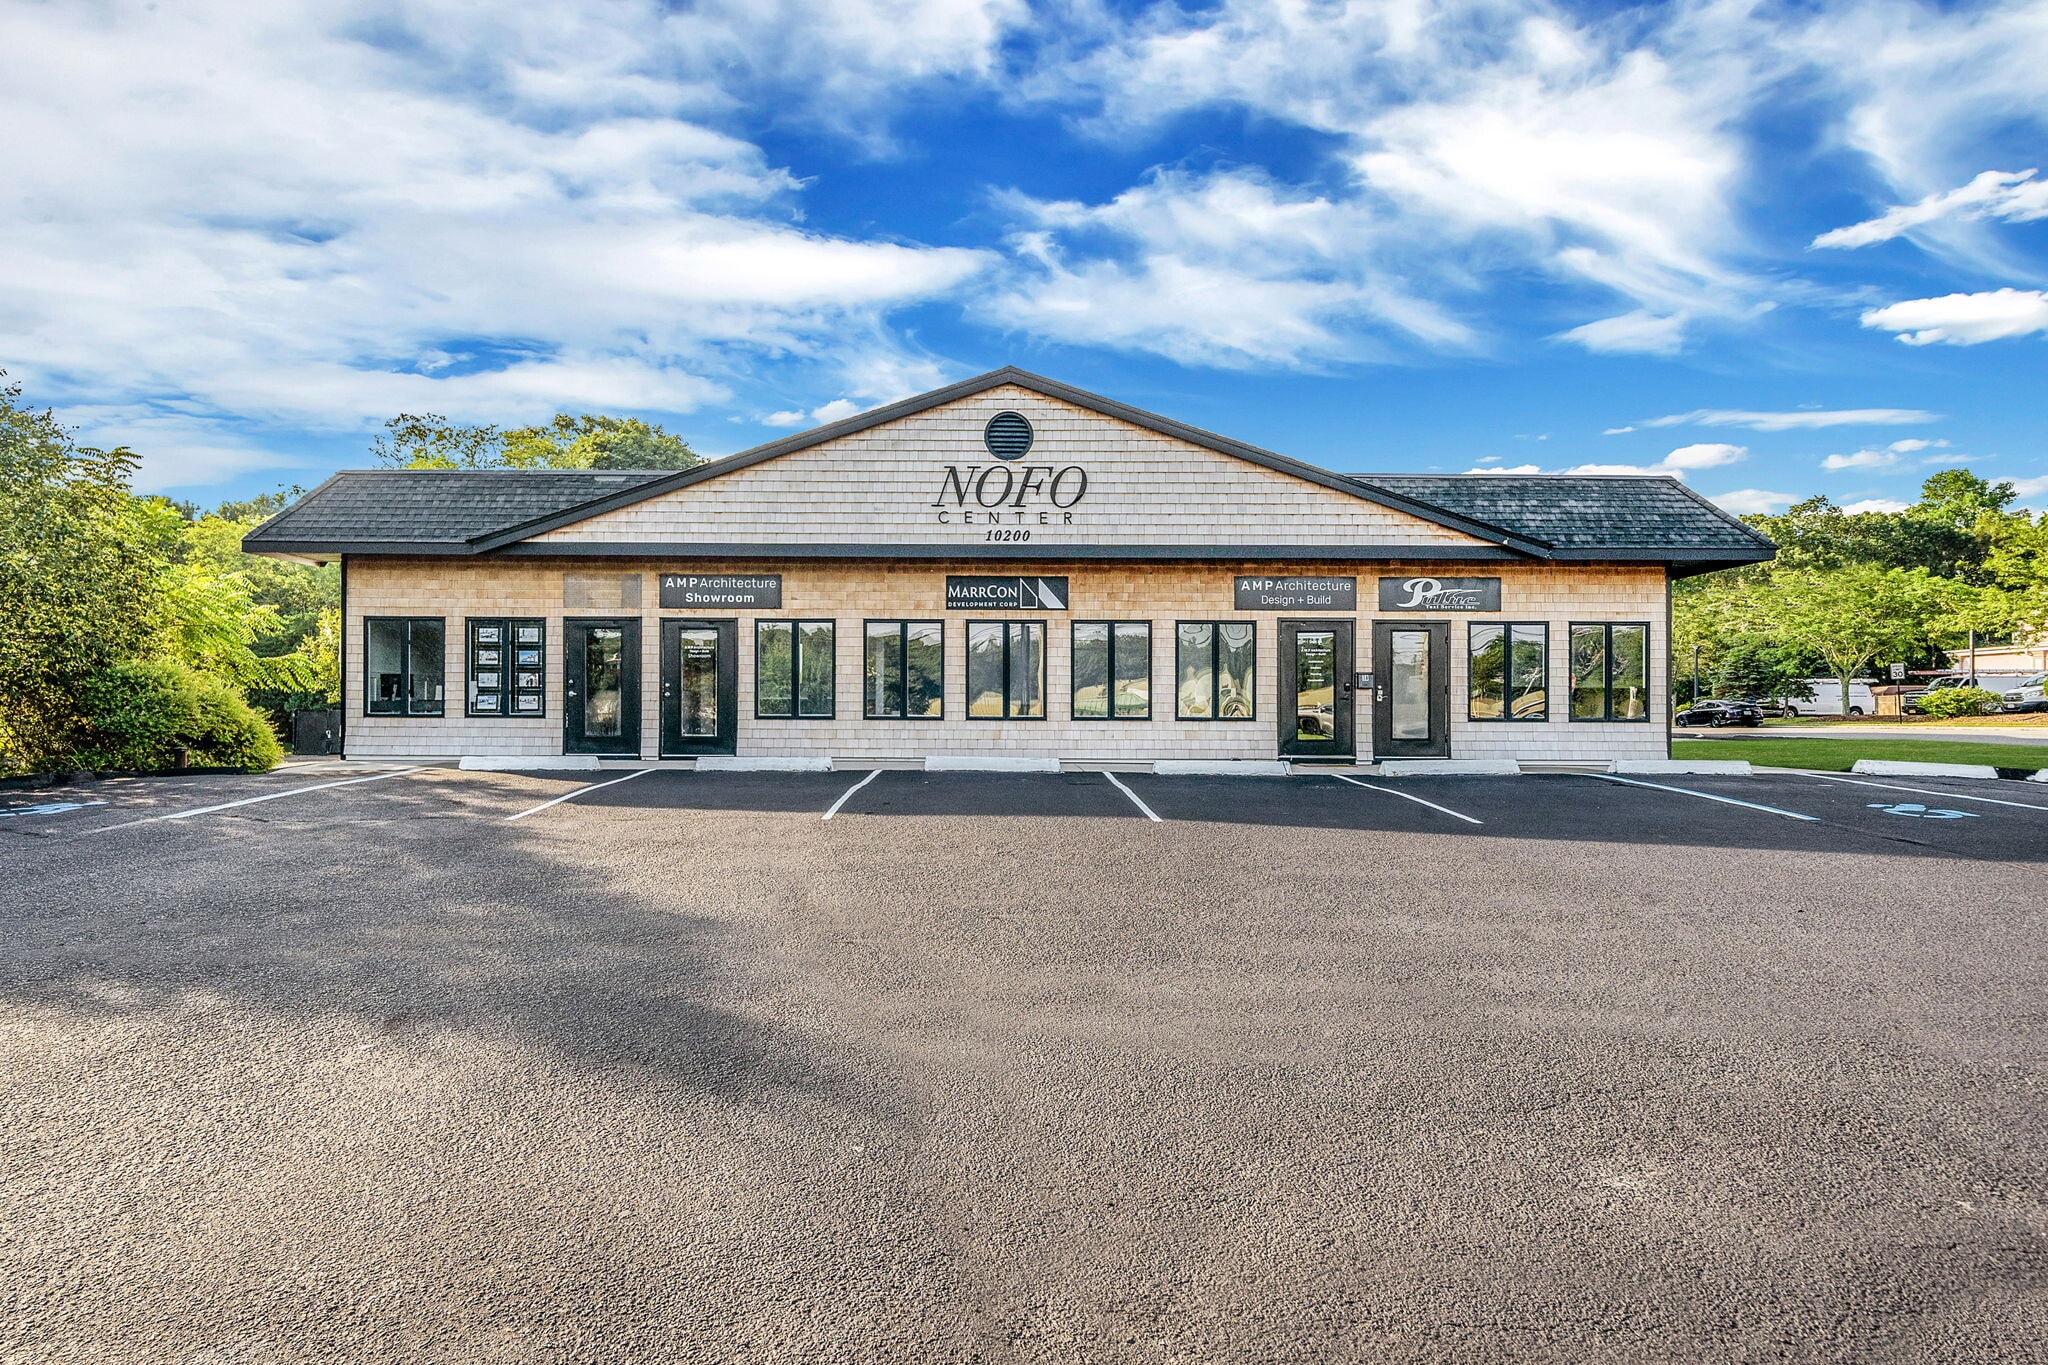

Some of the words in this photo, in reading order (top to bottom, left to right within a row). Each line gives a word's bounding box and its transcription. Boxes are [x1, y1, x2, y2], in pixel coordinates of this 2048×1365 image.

[931, 465, 1088, 509] NOFO
[938, 510, 1073, 525] CENTER
[985, 529, 1031, 542] 10200
[699, 577, 777, 589] Architecture
[1275, 580, 1351, 591] Architecture
[685, 592, 755, 603] Showroom
[1261, 595, 1295, 607] Design
[1306, 595, 1332, 605] Build
[1892, 670, 1903, 678] 30
